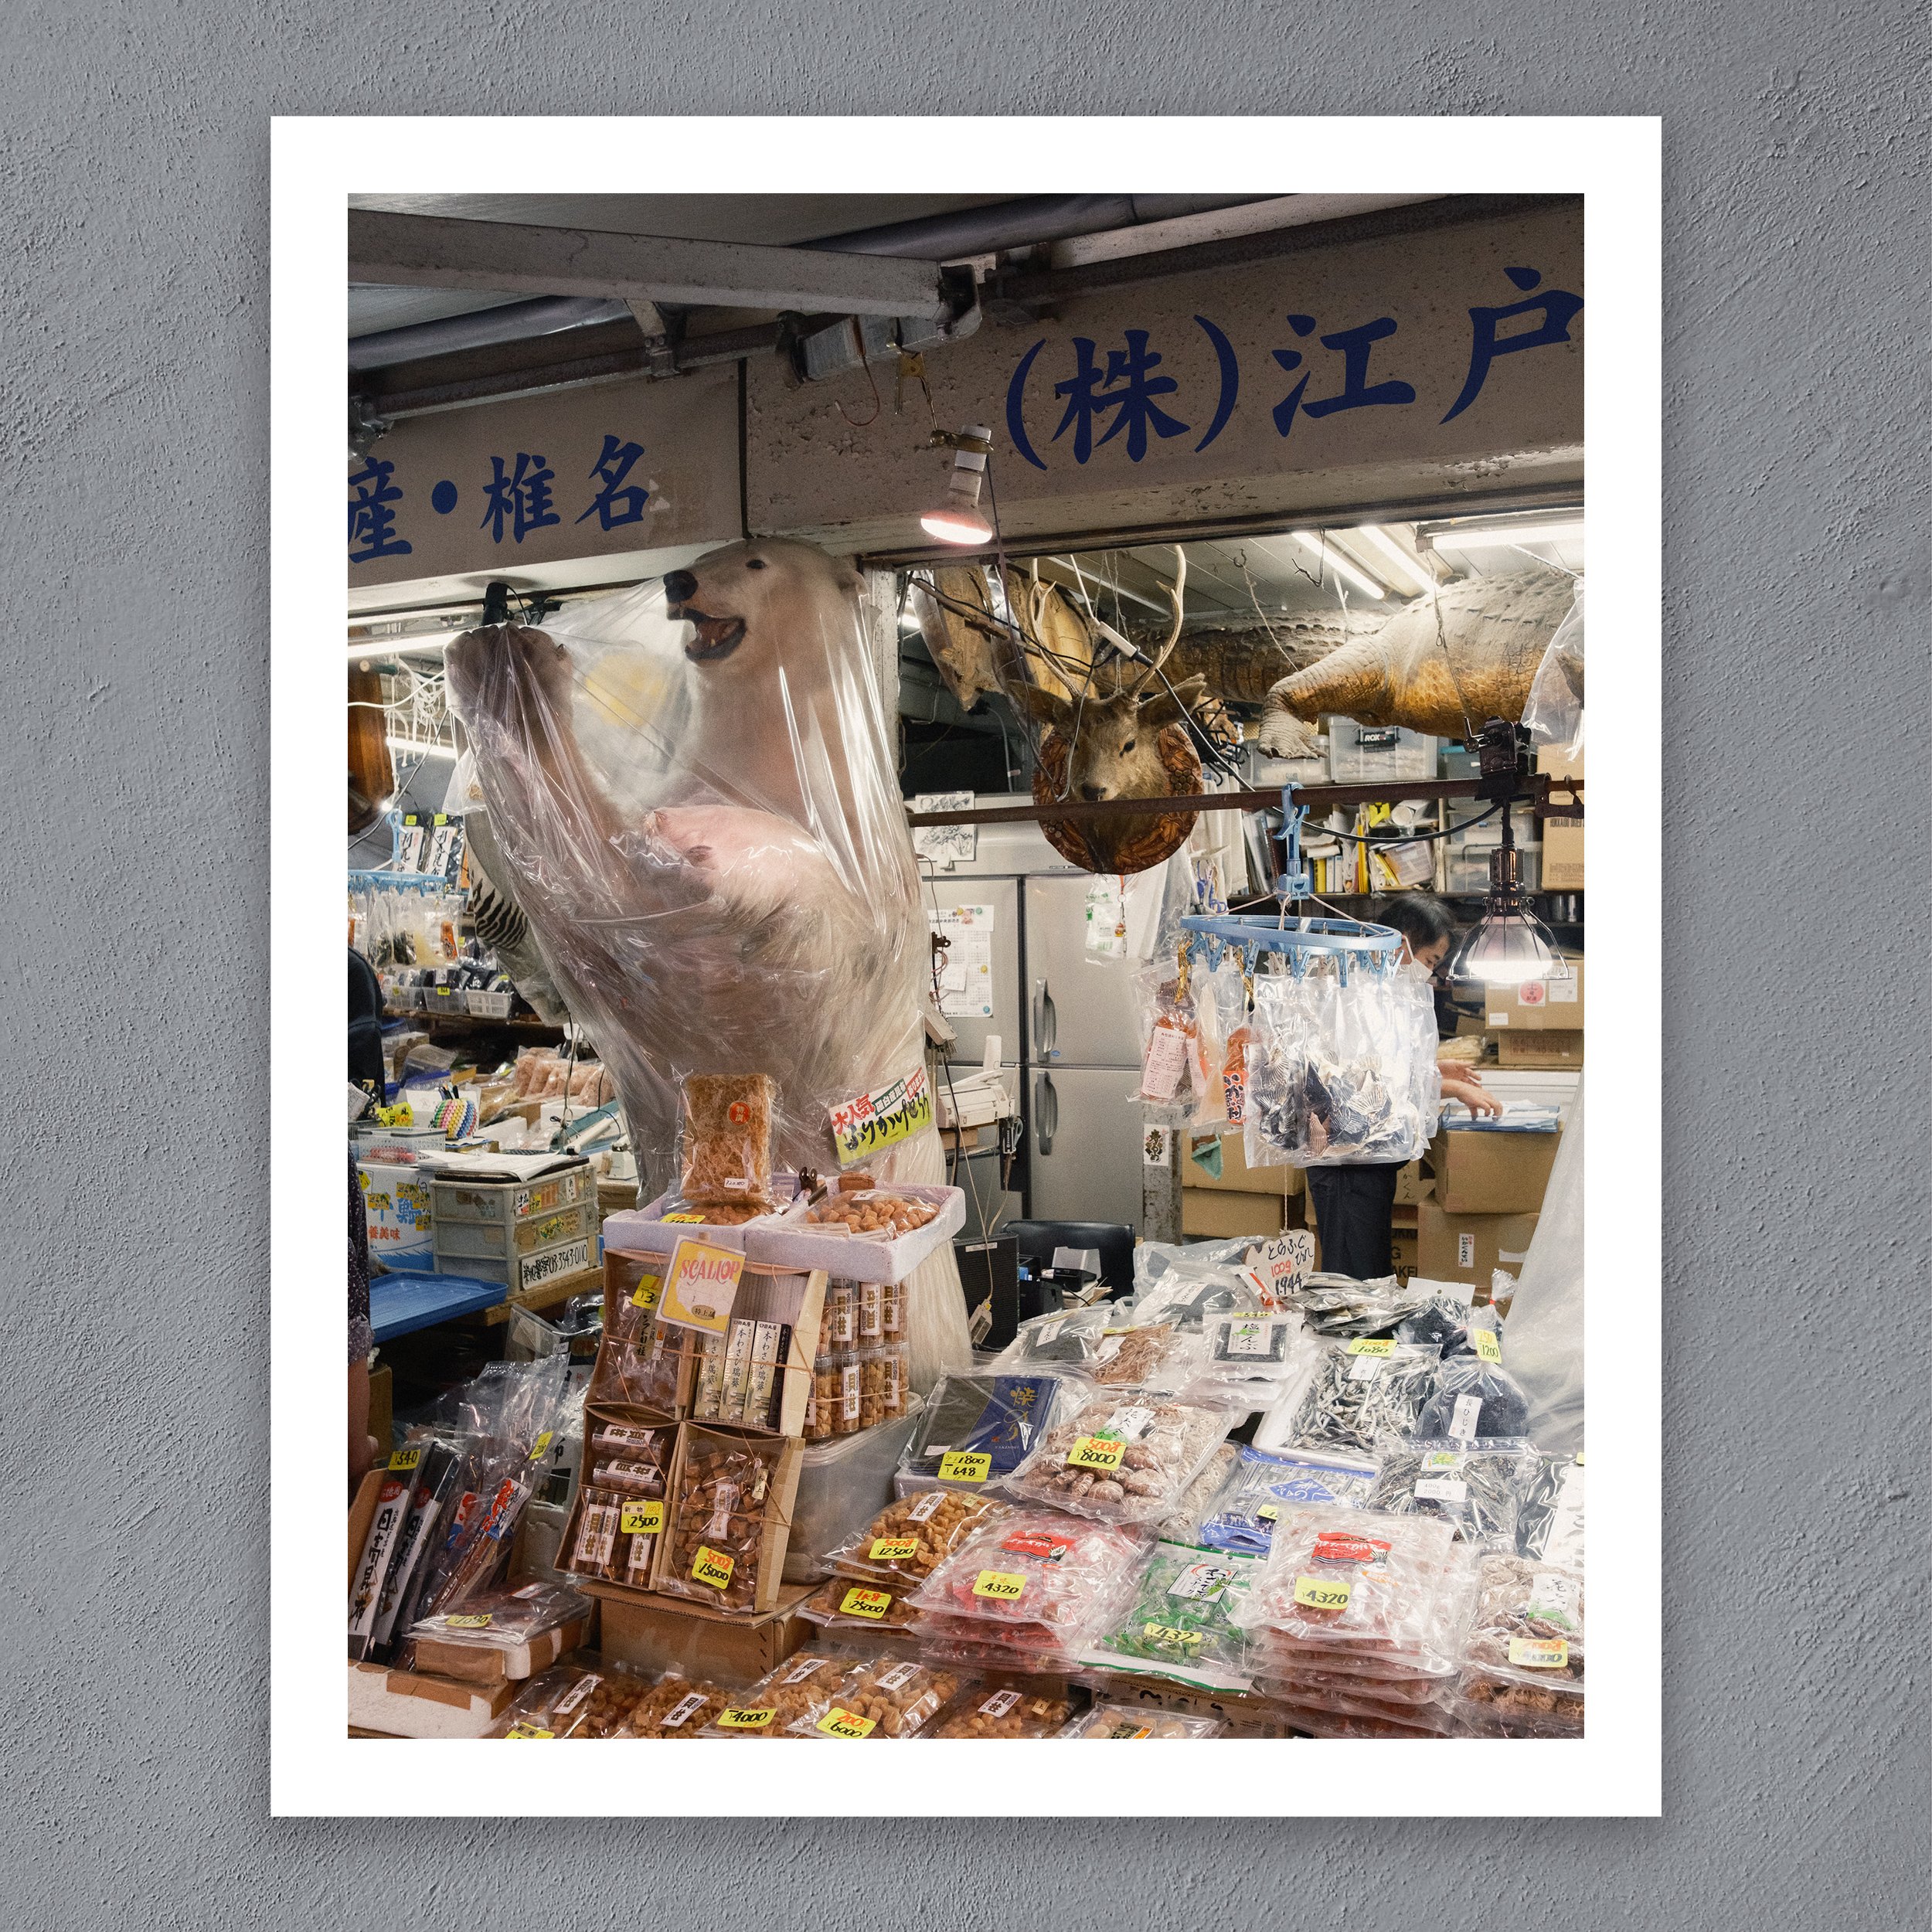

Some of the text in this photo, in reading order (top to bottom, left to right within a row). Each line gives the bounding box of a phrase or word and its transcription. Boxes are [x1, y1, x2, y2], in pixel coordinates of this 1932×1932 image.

[832, 1094, 876, 1136] 大人気
[1268, 1235, 1307, 1261] とらふぐ
[679, 1258, 741, 1286] SCALLOP
[1270, 1260, 1292, 1277] 100g
